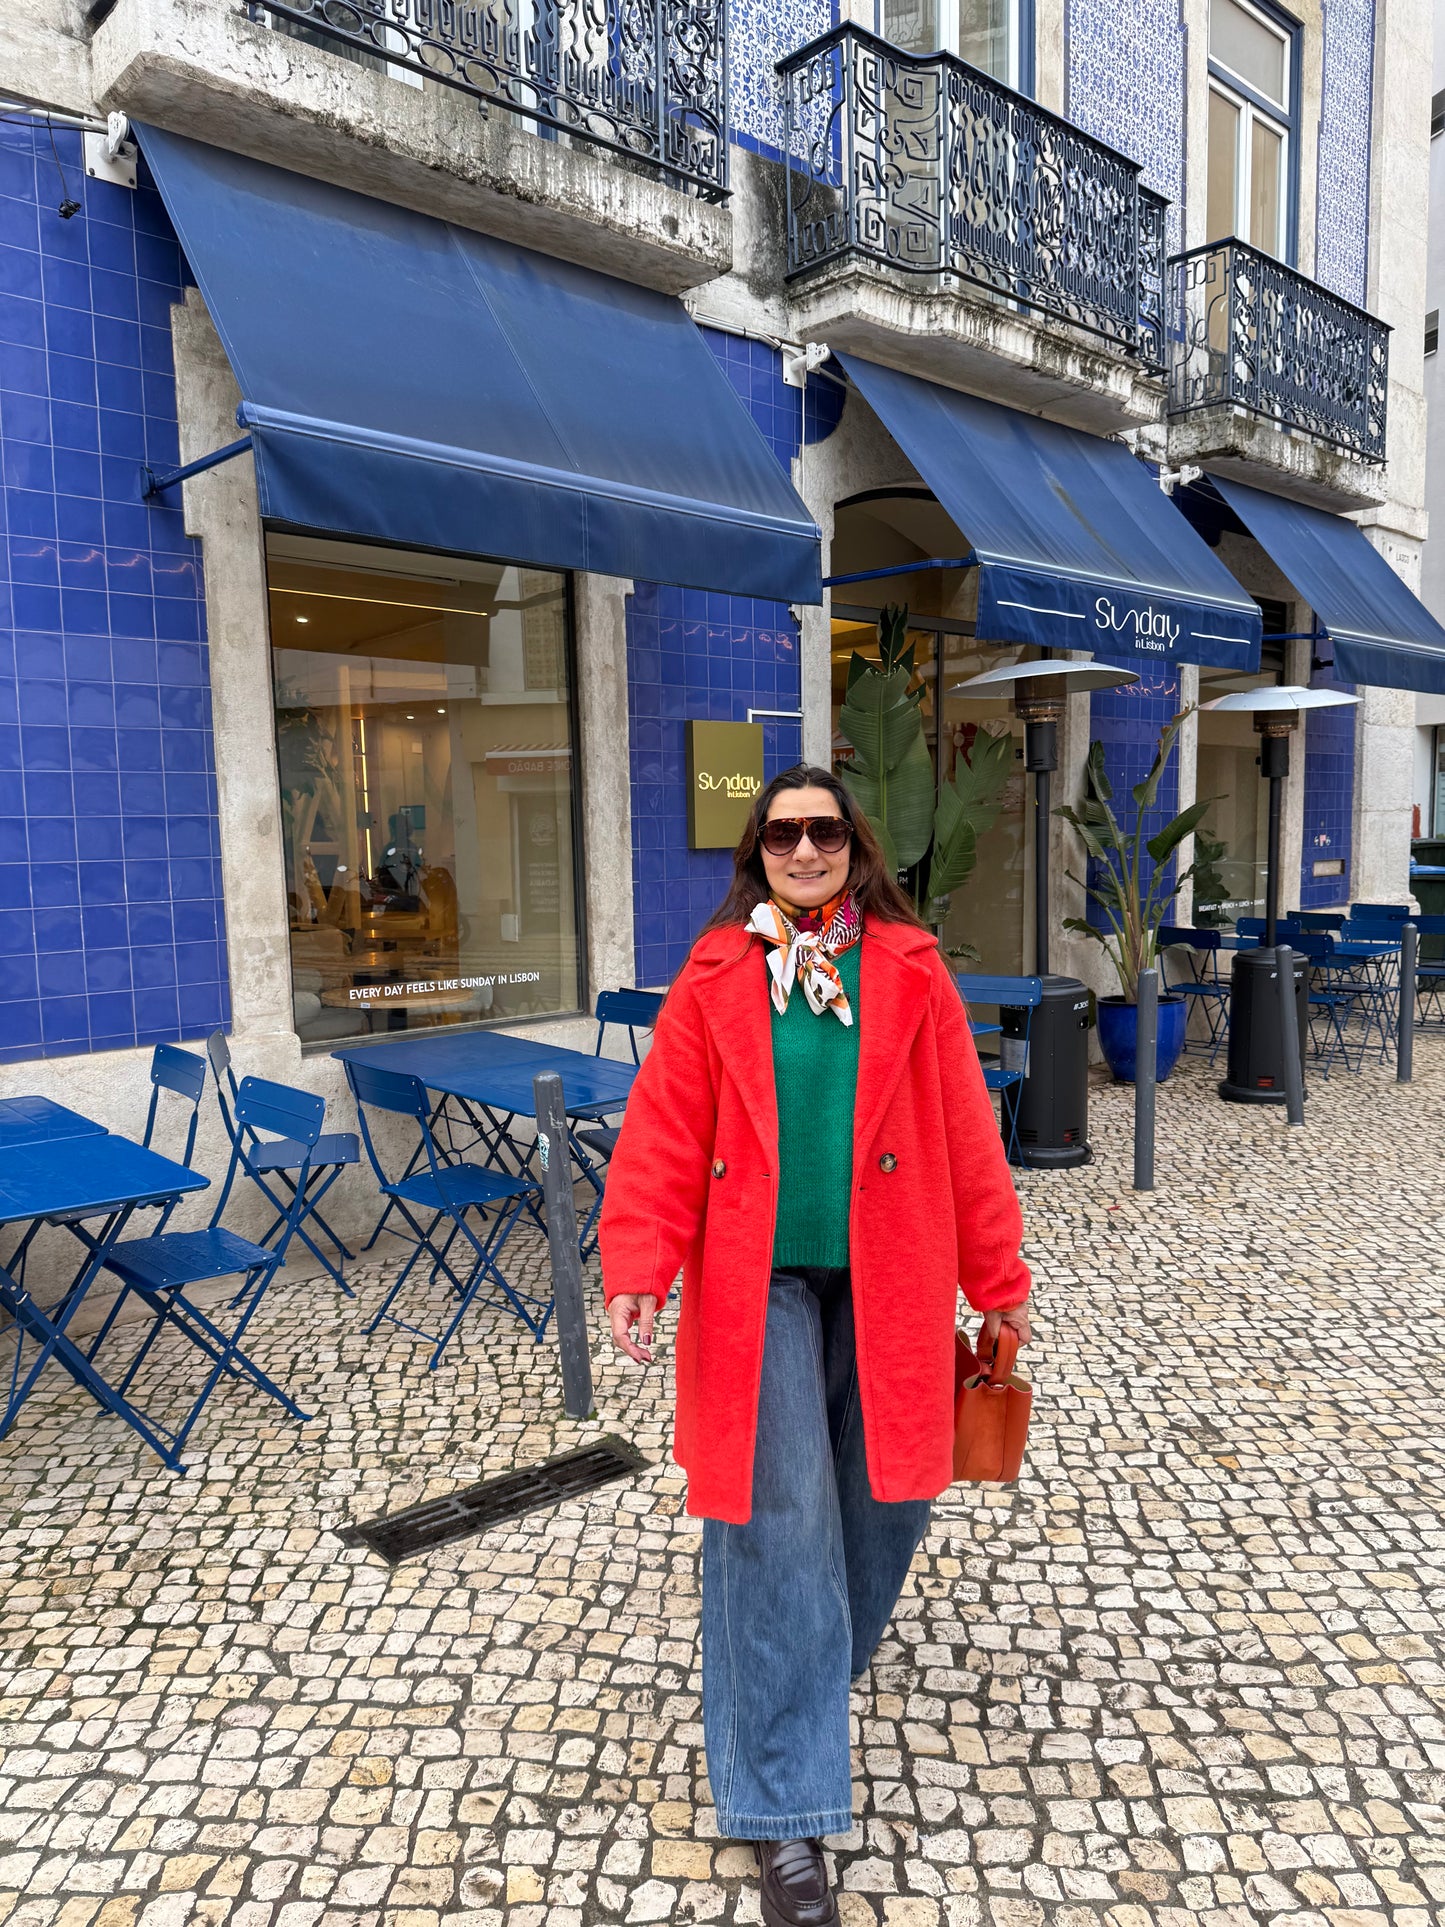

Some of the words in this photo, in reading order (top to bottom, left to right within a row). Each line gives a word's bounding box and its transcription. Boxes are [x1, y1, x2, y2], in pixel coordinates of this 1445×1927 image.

[1095, 597, 1180, 648] Sunday
[1135, 636, 1141, 648] in
[1141, 637, 1165, 652] Lisbon
[698, 772, 761, 796] Sunday
[727, 790, 733, 798] in
[733, 790, 751, 798] Lisbon
[349, 987, 382, 1000] EVERY
[384, 984, 404, 997] DAY
[406, 981, 436, 994] FEELS
[438, 979, 458, 991] LIKE
[460, 976, 496, 989] SUNDAY
[498, 974, 507, 985] IN
[509, 971, 540, 984] LISBON
